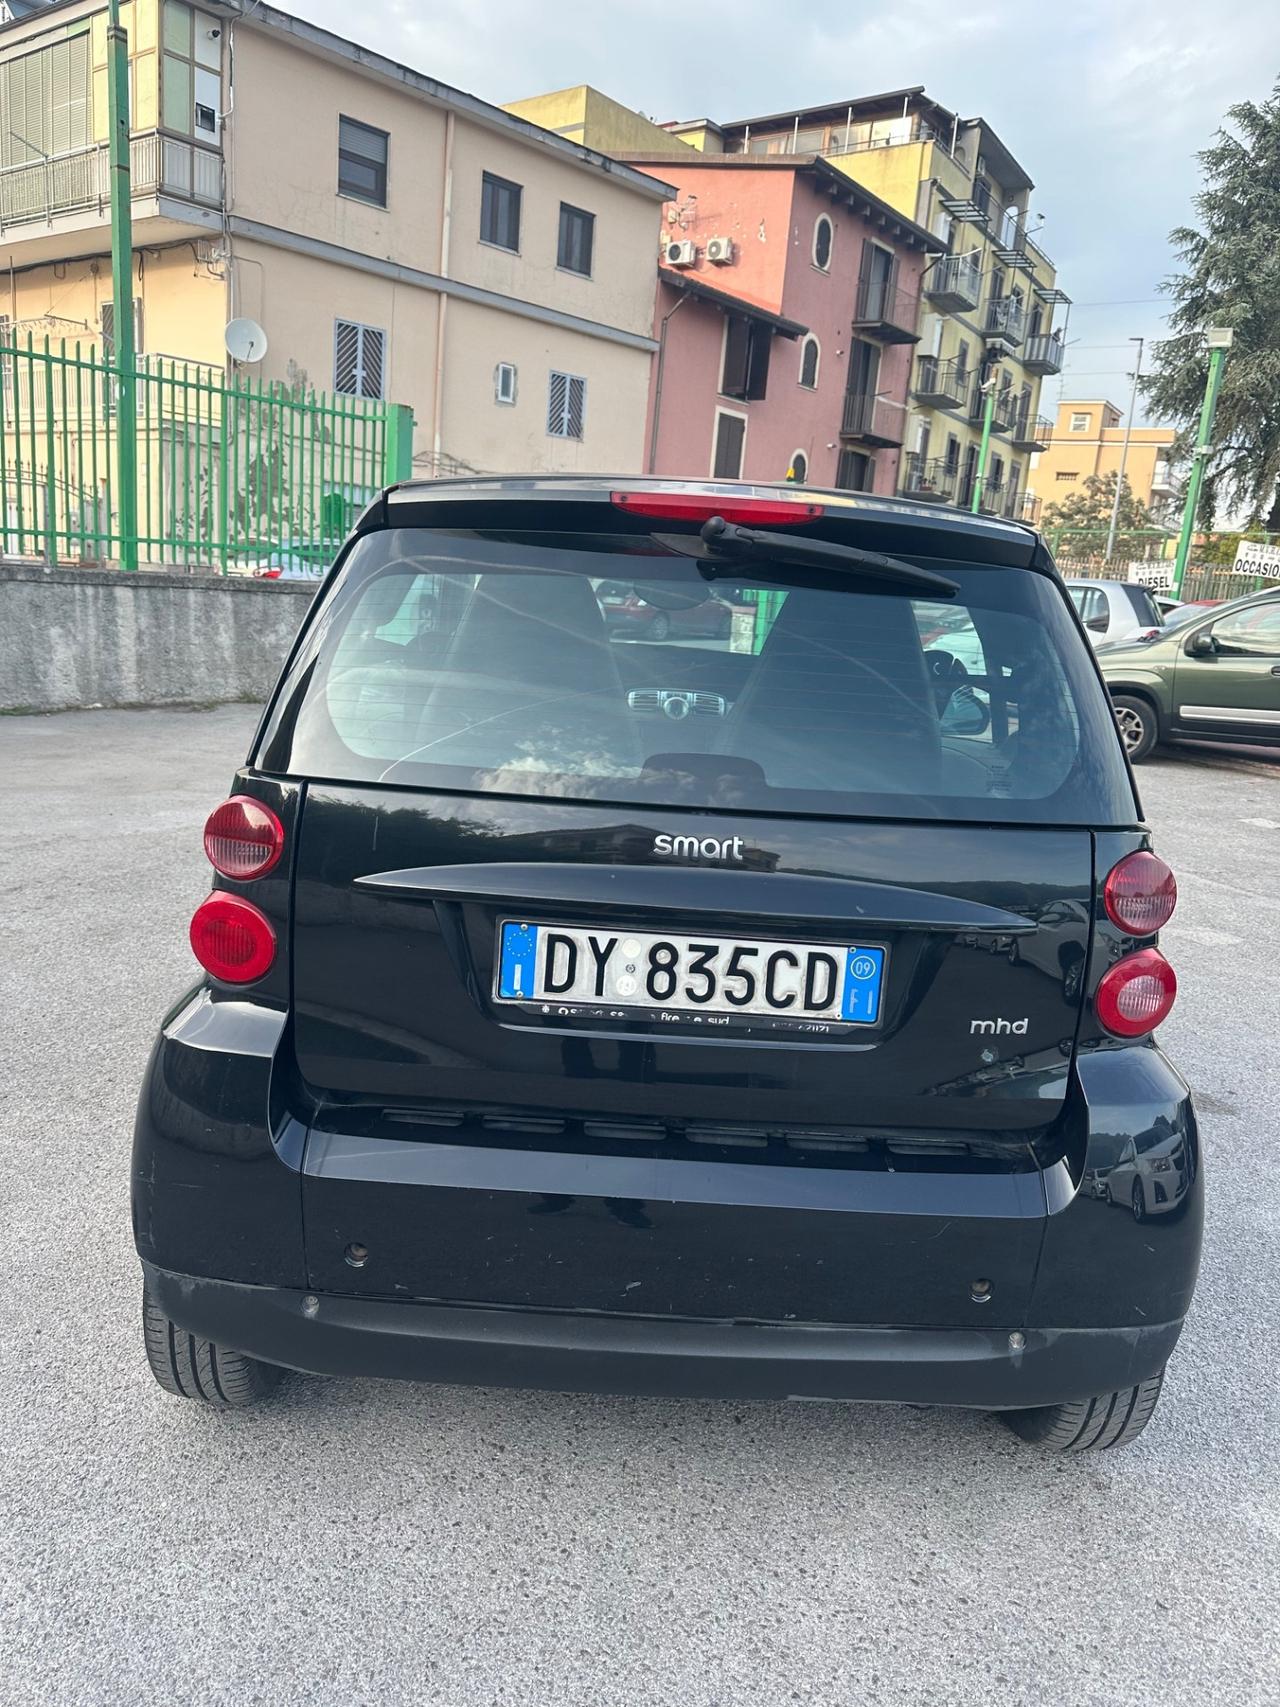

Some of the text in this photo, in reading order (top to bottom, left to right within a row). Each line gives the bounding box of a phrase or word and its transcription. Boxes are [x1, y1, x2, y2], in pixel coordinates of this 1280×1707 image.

[1235, 559, 1280, 577] OCCASIO
[1138, 576, 1170, 589] DIESEL
[653, 834, 743, 860] smart
[543, 933, 837, 1010] DY 835CD
[855, 961, 871, 975] 09
[970, 1017, 1029, 1034] mhd
